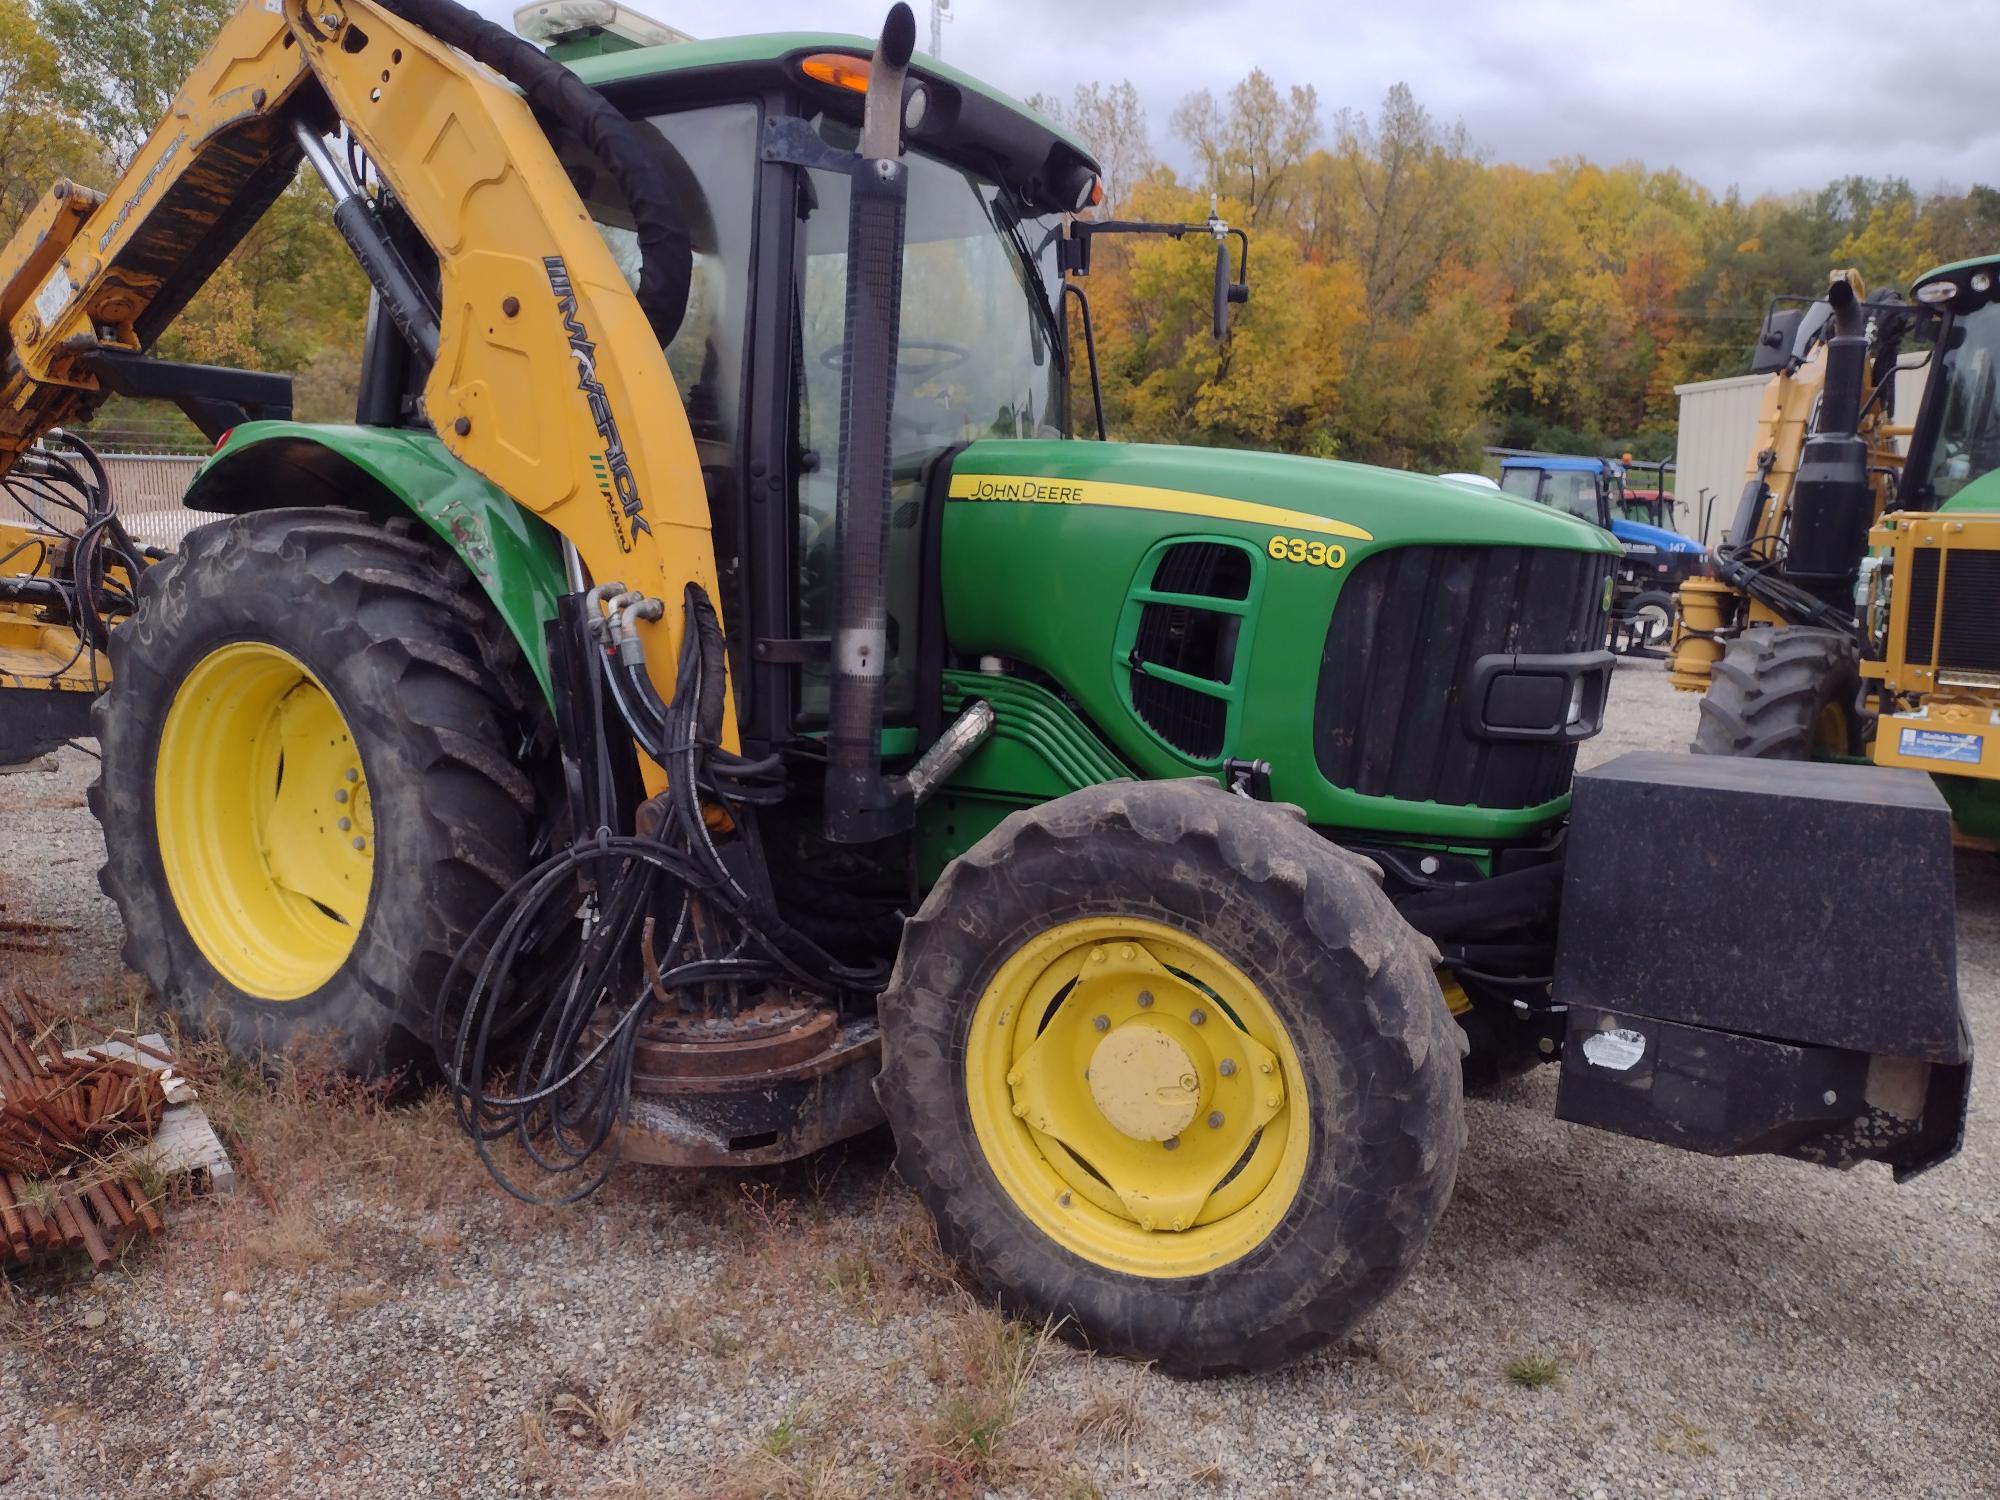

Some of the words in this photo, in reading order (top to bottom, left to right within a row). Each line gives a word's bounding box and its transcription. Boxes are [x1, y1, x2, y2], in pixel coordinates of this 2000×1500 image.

[557, 294, 654, 547] MAVERICK
[971, 480, 1020, 498] JOHN
[1023, 482, 1083, 502] DEERE
[1268, 535, 1346, 569] 6330
[1669, 542, 1686, 552] 147
